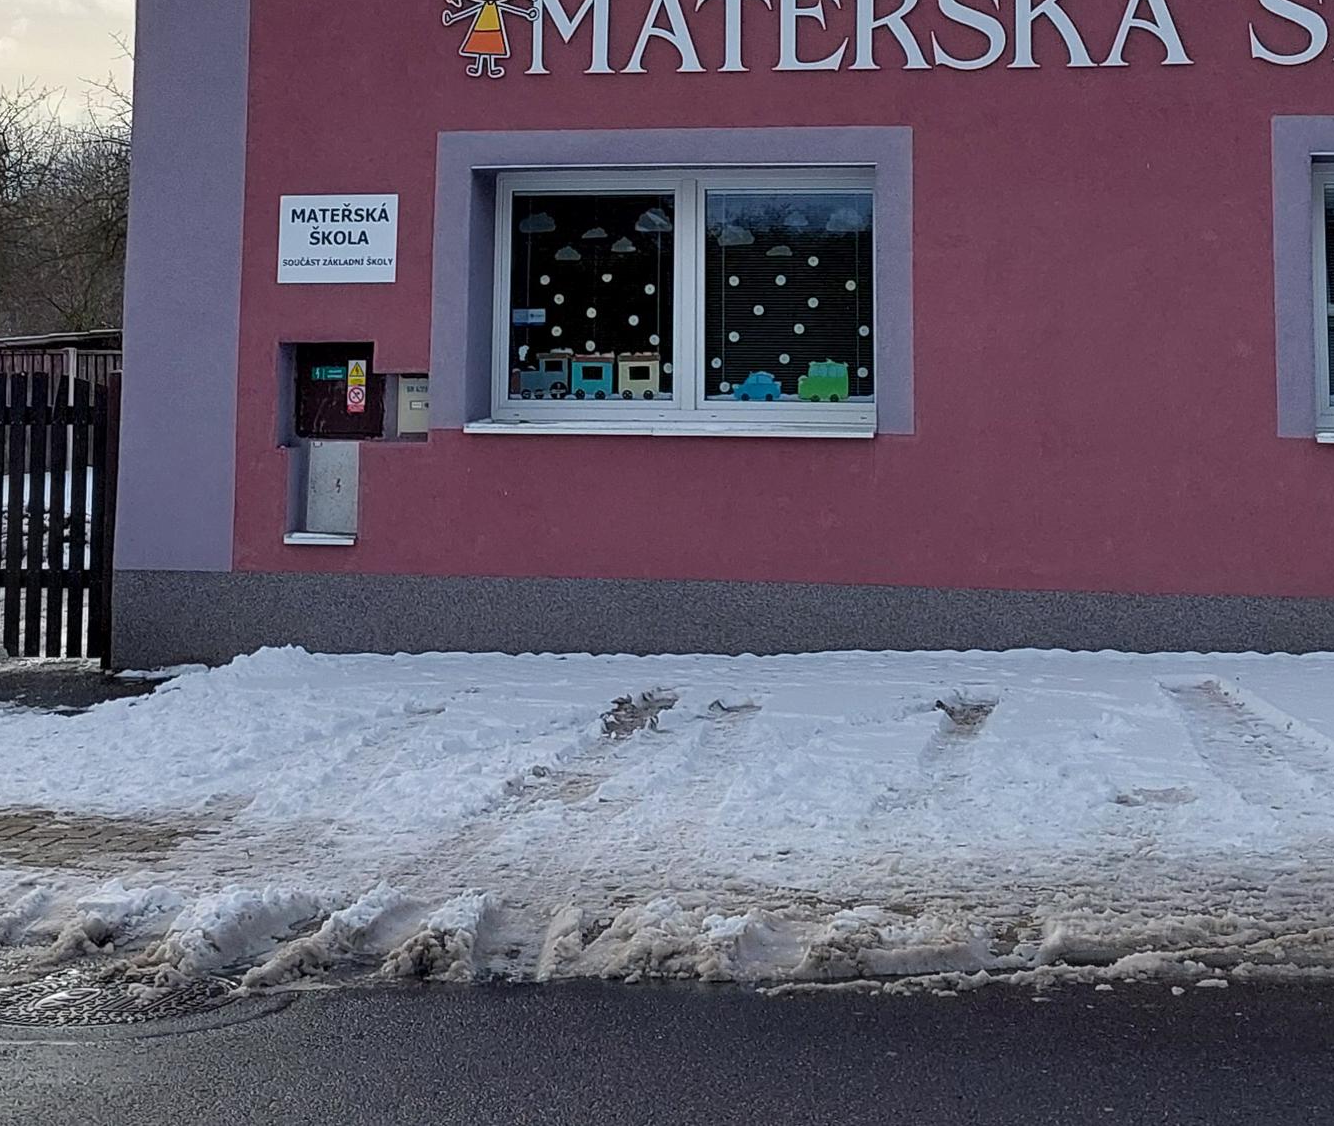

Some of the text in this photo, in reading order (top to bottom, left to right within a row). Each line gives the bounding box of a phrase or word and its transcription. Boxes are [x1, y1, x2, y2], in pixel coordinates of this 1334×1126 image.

[291, 202, 390, 223] MATEŘSKÁ
[309, 225, 370, 246] ŠKOLA
[282, 256, 321, 267] SOUČÁST
[366, 255, 394, 266] ŠKOLY
